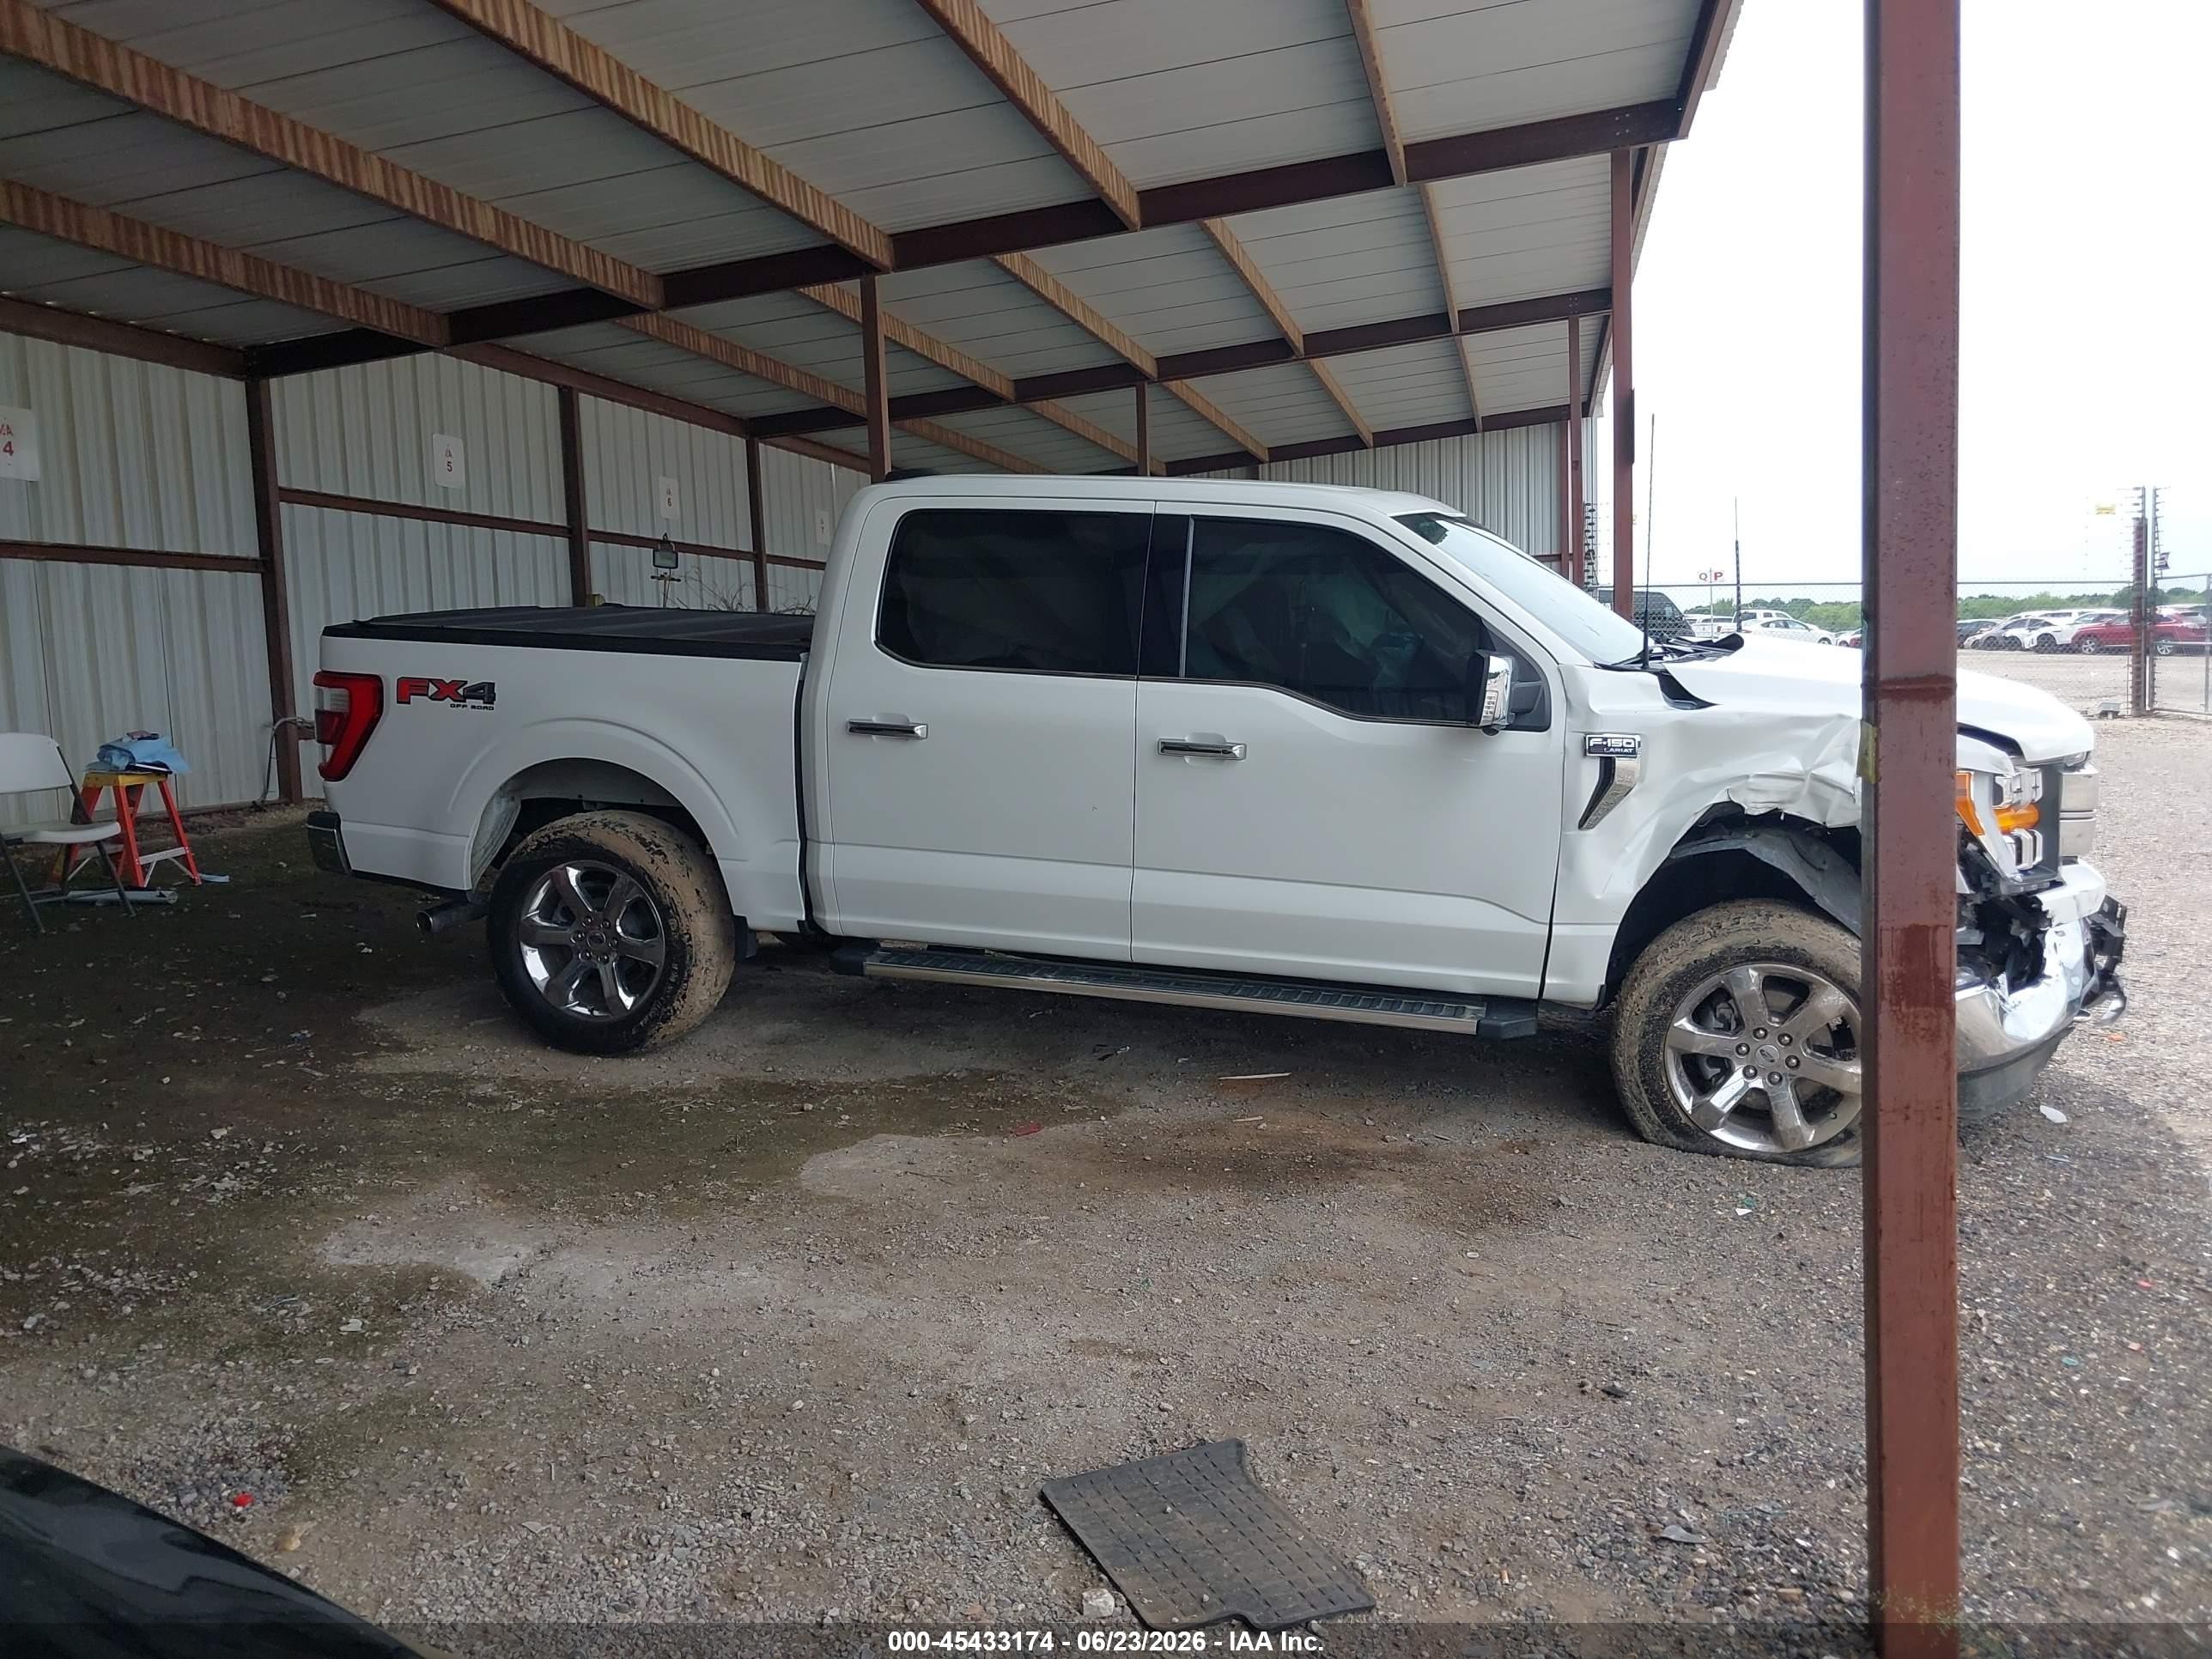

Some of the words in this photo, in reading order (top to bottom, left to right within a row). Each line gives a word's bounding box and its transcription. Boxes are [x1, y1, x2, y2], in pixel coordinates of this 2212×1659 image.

[3, 441, 14, 457] 4
[447, 460, 453, 472] 5
[1698, 572, 1708, 581] Q
[1713, 571, 1723, 581] P
[396, 676, 496, 705] FX4
[1589, 738, 1635, 747] F-150
